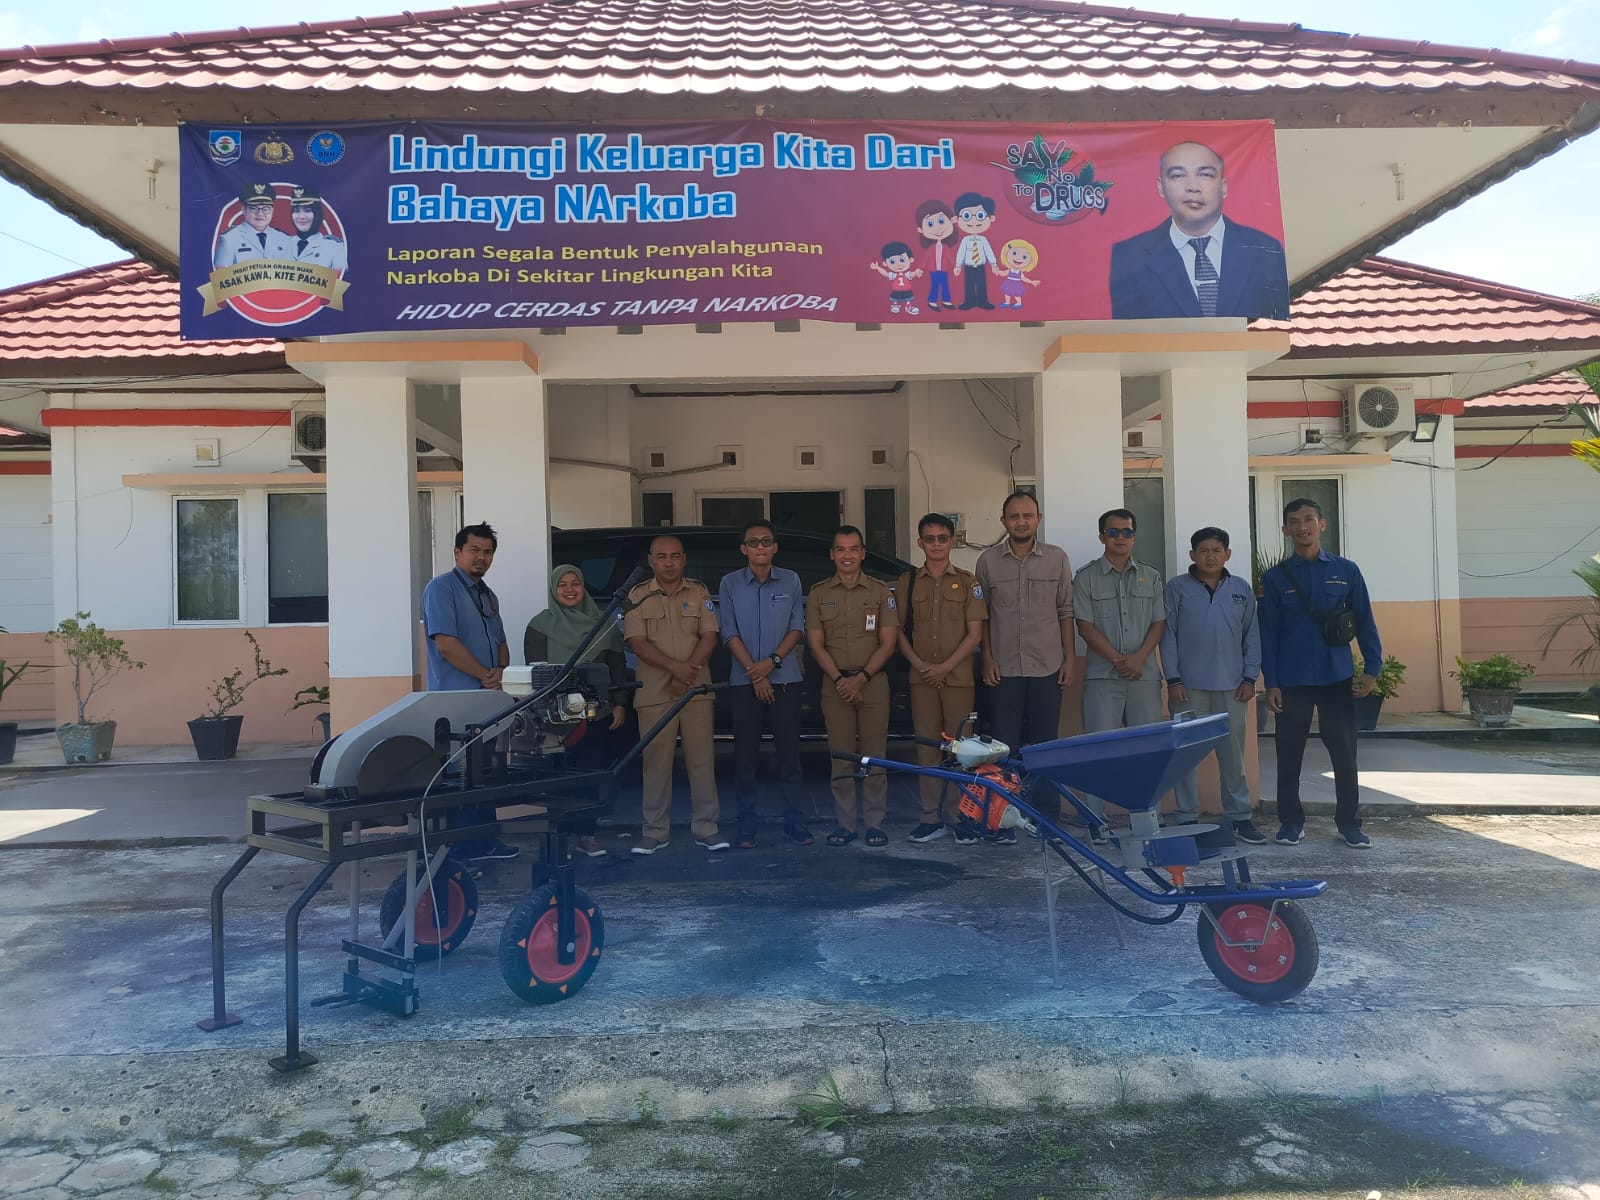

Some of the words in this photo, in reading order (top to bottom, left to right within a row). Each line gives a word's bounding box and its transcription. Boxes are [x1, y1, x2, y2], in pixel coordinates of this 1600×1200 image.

[390, 134, 566, 180] Lindungi
[577, 133, 764, 177] Keluarga
[774, 132, 855, 170] Kita
[864, 133, 955, 170] Dari
[1006, 139, 1067, 169] SAY
[388, 183, 544, 231] Bahaya
[555, 183, 736, 223] NArkoba
[1033, 182, 1105, 212] DRUGS
[387, 247, 475, 263] Laporan
[482, 245, 554, 262] Segala
[561, 245, 639, 260] Bentuk
[646, 240, 823, 258] Penyalahgunaan
[219, 275, 243, 290] ASAK
[244, 271, 272, 283] KAWA,
[274, 271, 295, 281] KITE
[297, 273, 329, 288] PACAK
[387, 269, 480, 285] Narkoba
[487, 268, 510, 283] Di
[516, 268, 594, 284] Sekitar
[601, 266, 724, 284] Lingkungan
[731, 264, 774, 278] Kita
[396, 303, 492, 320] HIDUP
[494, 301, 606, 318] CERDAS
[609, 298, 698, 316] TANPA
[702, 294, 838, 313] NARKOBA
